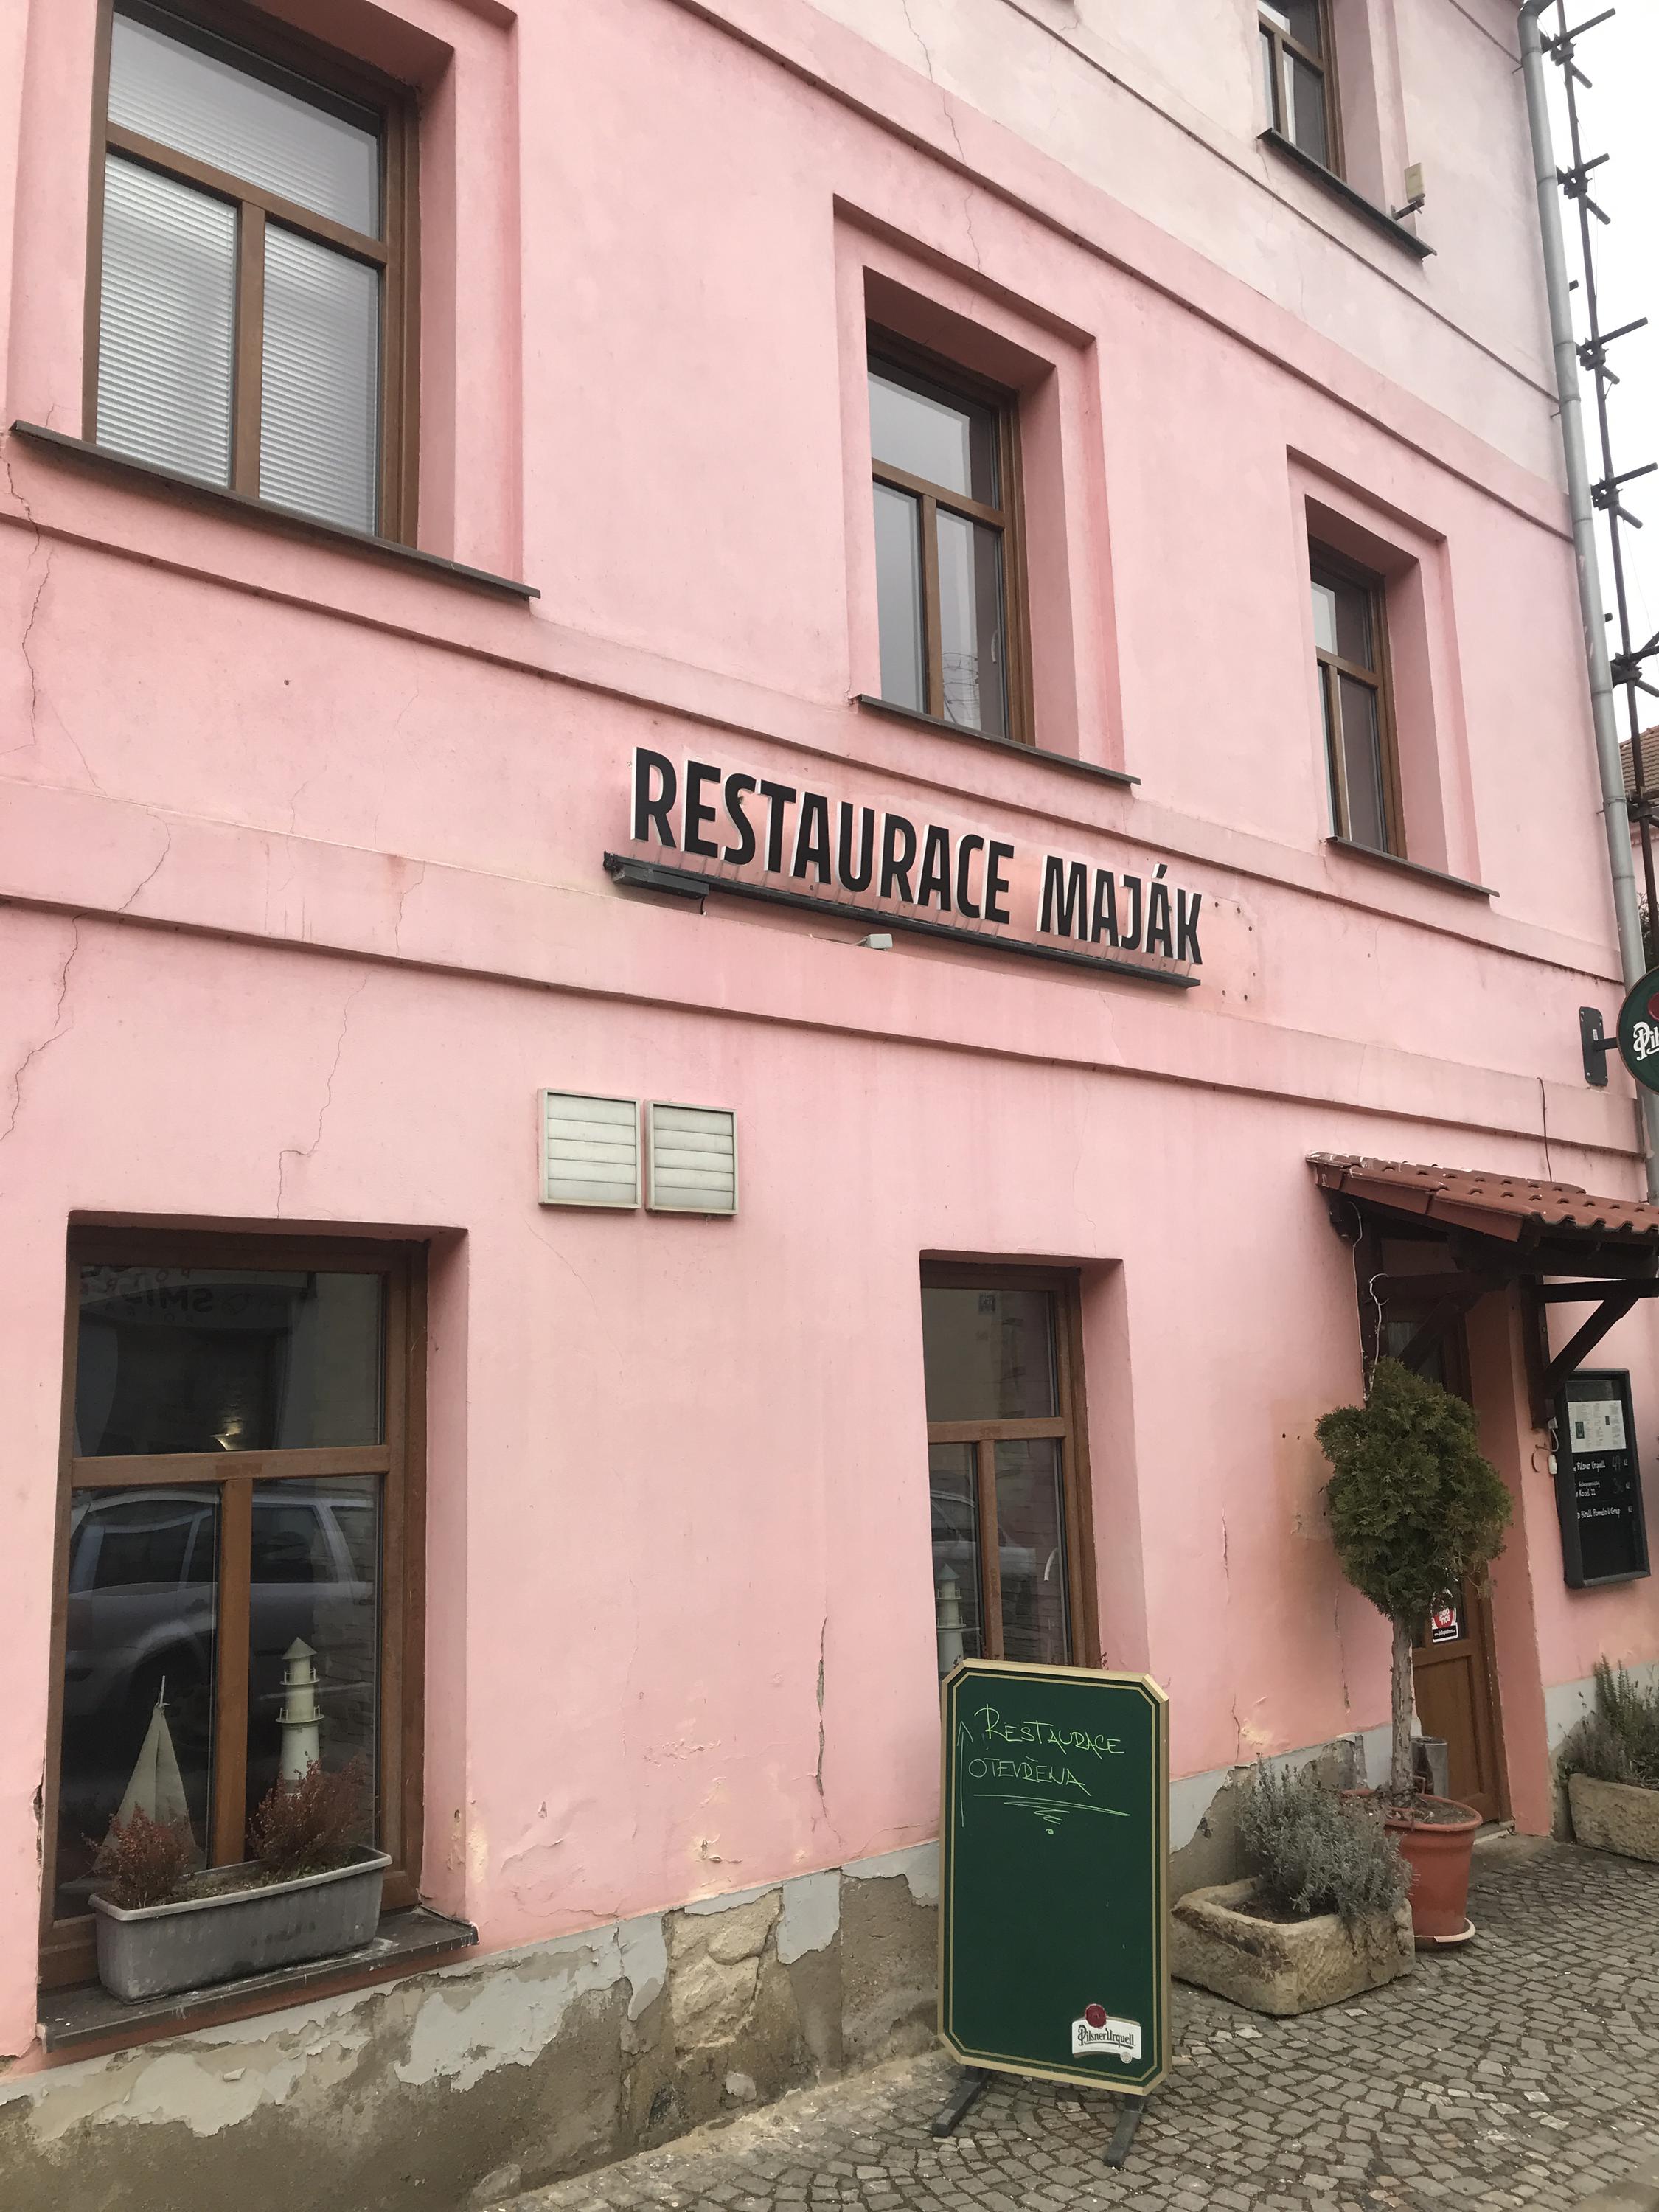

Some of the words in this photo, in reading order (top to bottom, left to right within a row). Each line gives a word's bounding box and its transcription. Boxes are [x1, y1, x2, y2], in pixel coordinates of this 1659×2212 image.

[630, 746, 1015, 924] RESTAURACE
[1038, 855, 1203, 964] MAJÁK
[1077, 2025, 1107, 2046] Pilsner
[1105, 2028, 1135, 2048] Urquell
